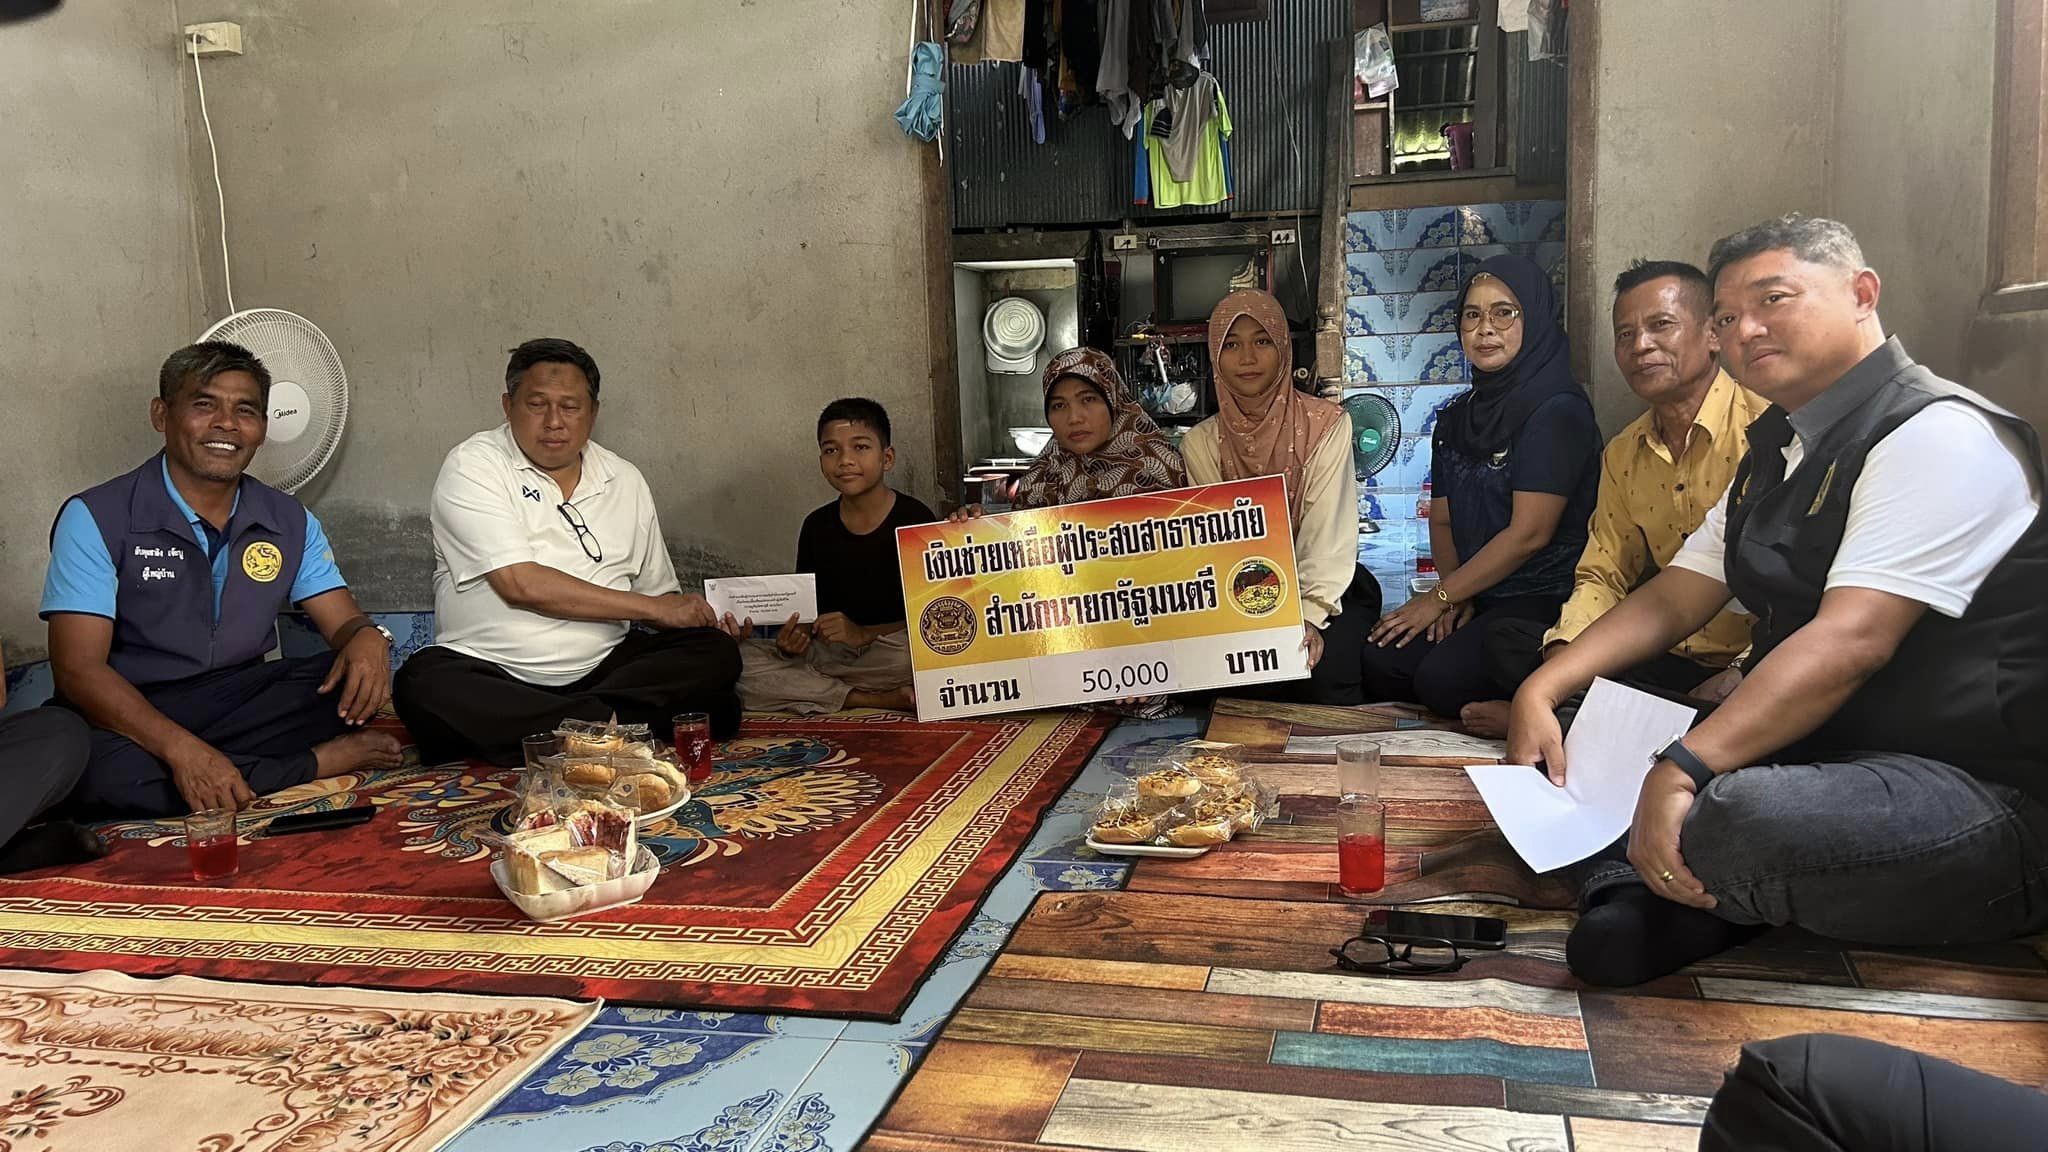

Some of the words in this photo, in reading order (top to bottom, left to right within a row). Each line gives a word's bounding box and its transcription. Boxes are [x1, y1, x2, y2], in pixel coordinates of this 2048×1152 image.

[273, 408, 298, 420] Midea
[924, 499, 1265, 581] เงินช่วยเหลือผู้ประสบสาธารณภัย
[142, 566, 176, 581] ผู้ใหญ่บ้าน
[985, 566, 1218, 632] สำนักนายกรัฐมนตรี
[939, 678, 1021, 708] จำนวน
[1081, 660, 1170, 694] 50,000
[1225, 645, 1279, 675] บาท
